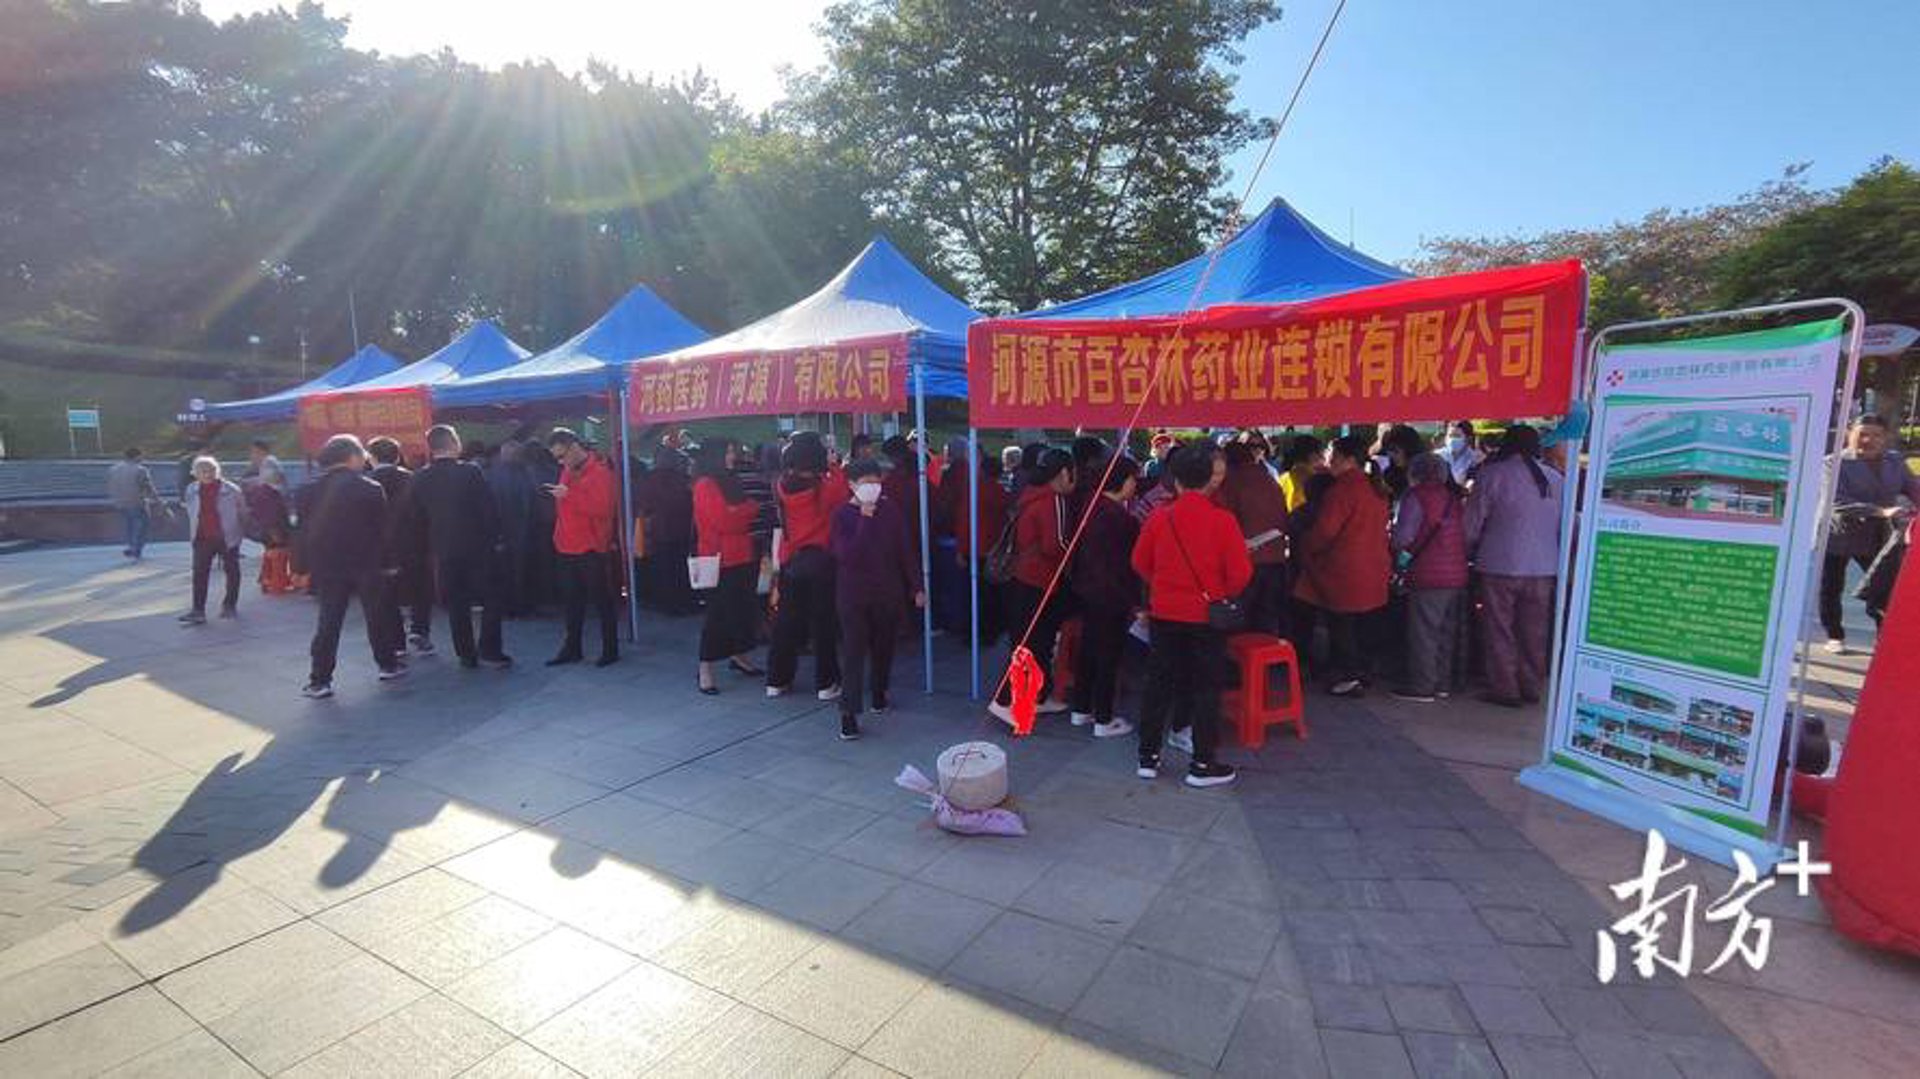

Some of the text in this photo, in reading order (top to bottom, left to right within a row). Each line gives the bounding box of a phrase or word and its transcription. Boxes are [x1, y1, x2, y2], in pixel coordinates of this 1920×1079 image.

[990, 293, 1546, 407] 河源市百杏林药业连锁有限公司
